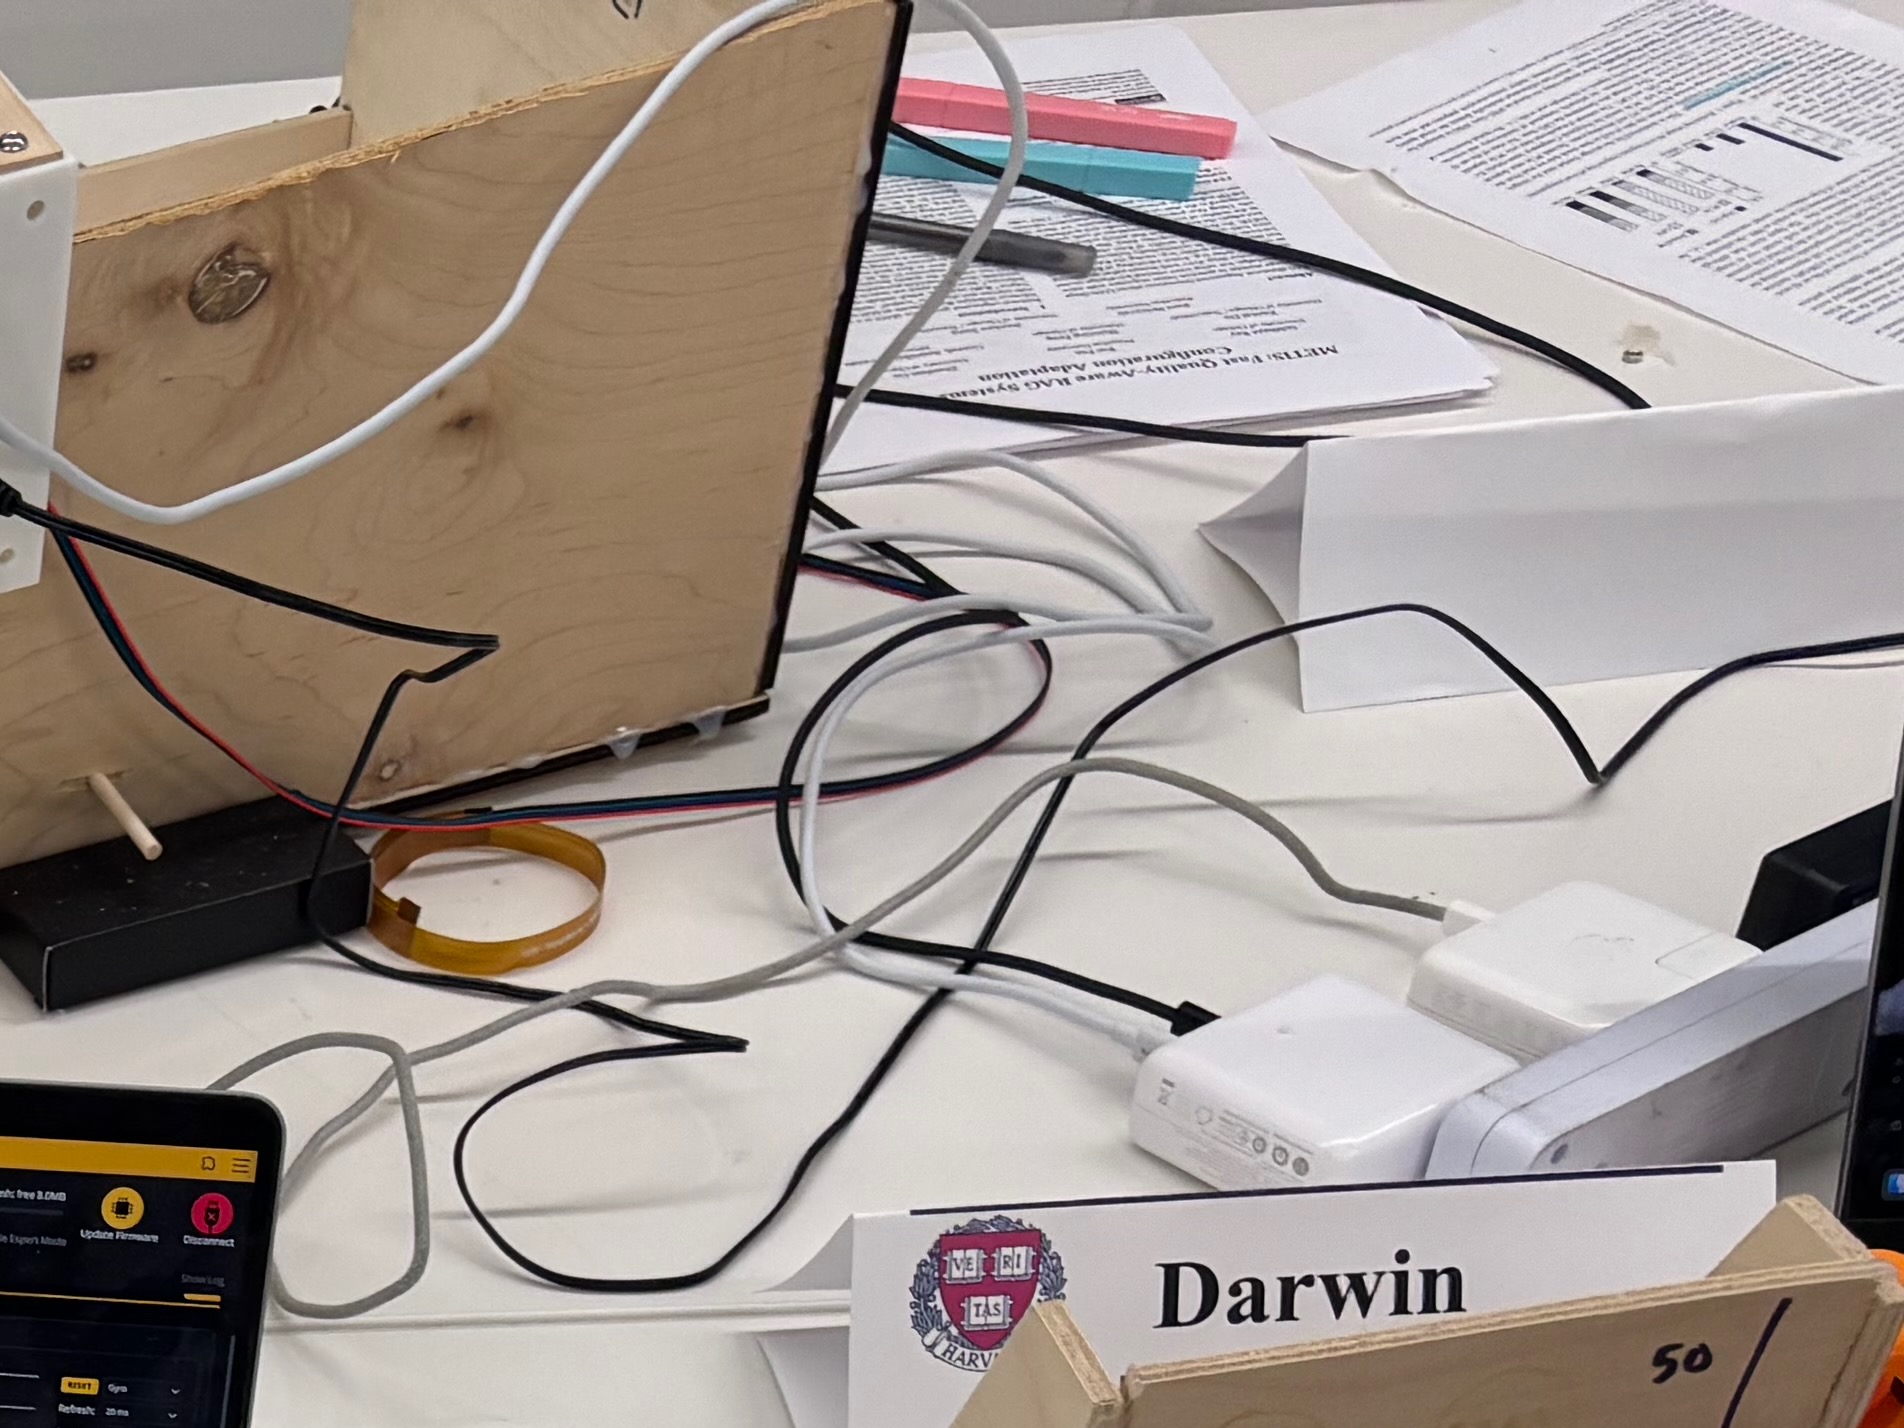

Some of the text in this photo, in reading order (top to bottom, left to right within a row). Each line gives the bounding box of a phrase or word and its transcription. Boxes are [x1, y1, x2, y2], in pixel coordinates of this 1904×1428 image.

[977, 346, 1232, 382] Configuration Adaptation
[1267, 345, 1339, 363] METIS:
[1023, 374, 1073, 391] RAG
[1075, 356, 1219, 384] Quality-Aware
[953, 1253, 1022, 1273] VE RI
[1154, 1249, 1468, 1331] Darwin
[973, 1302, 1002, 1319] TAS
[941, 1342, 998, 1369] HARV
[1652, 1343, 1712, 1384] 50
